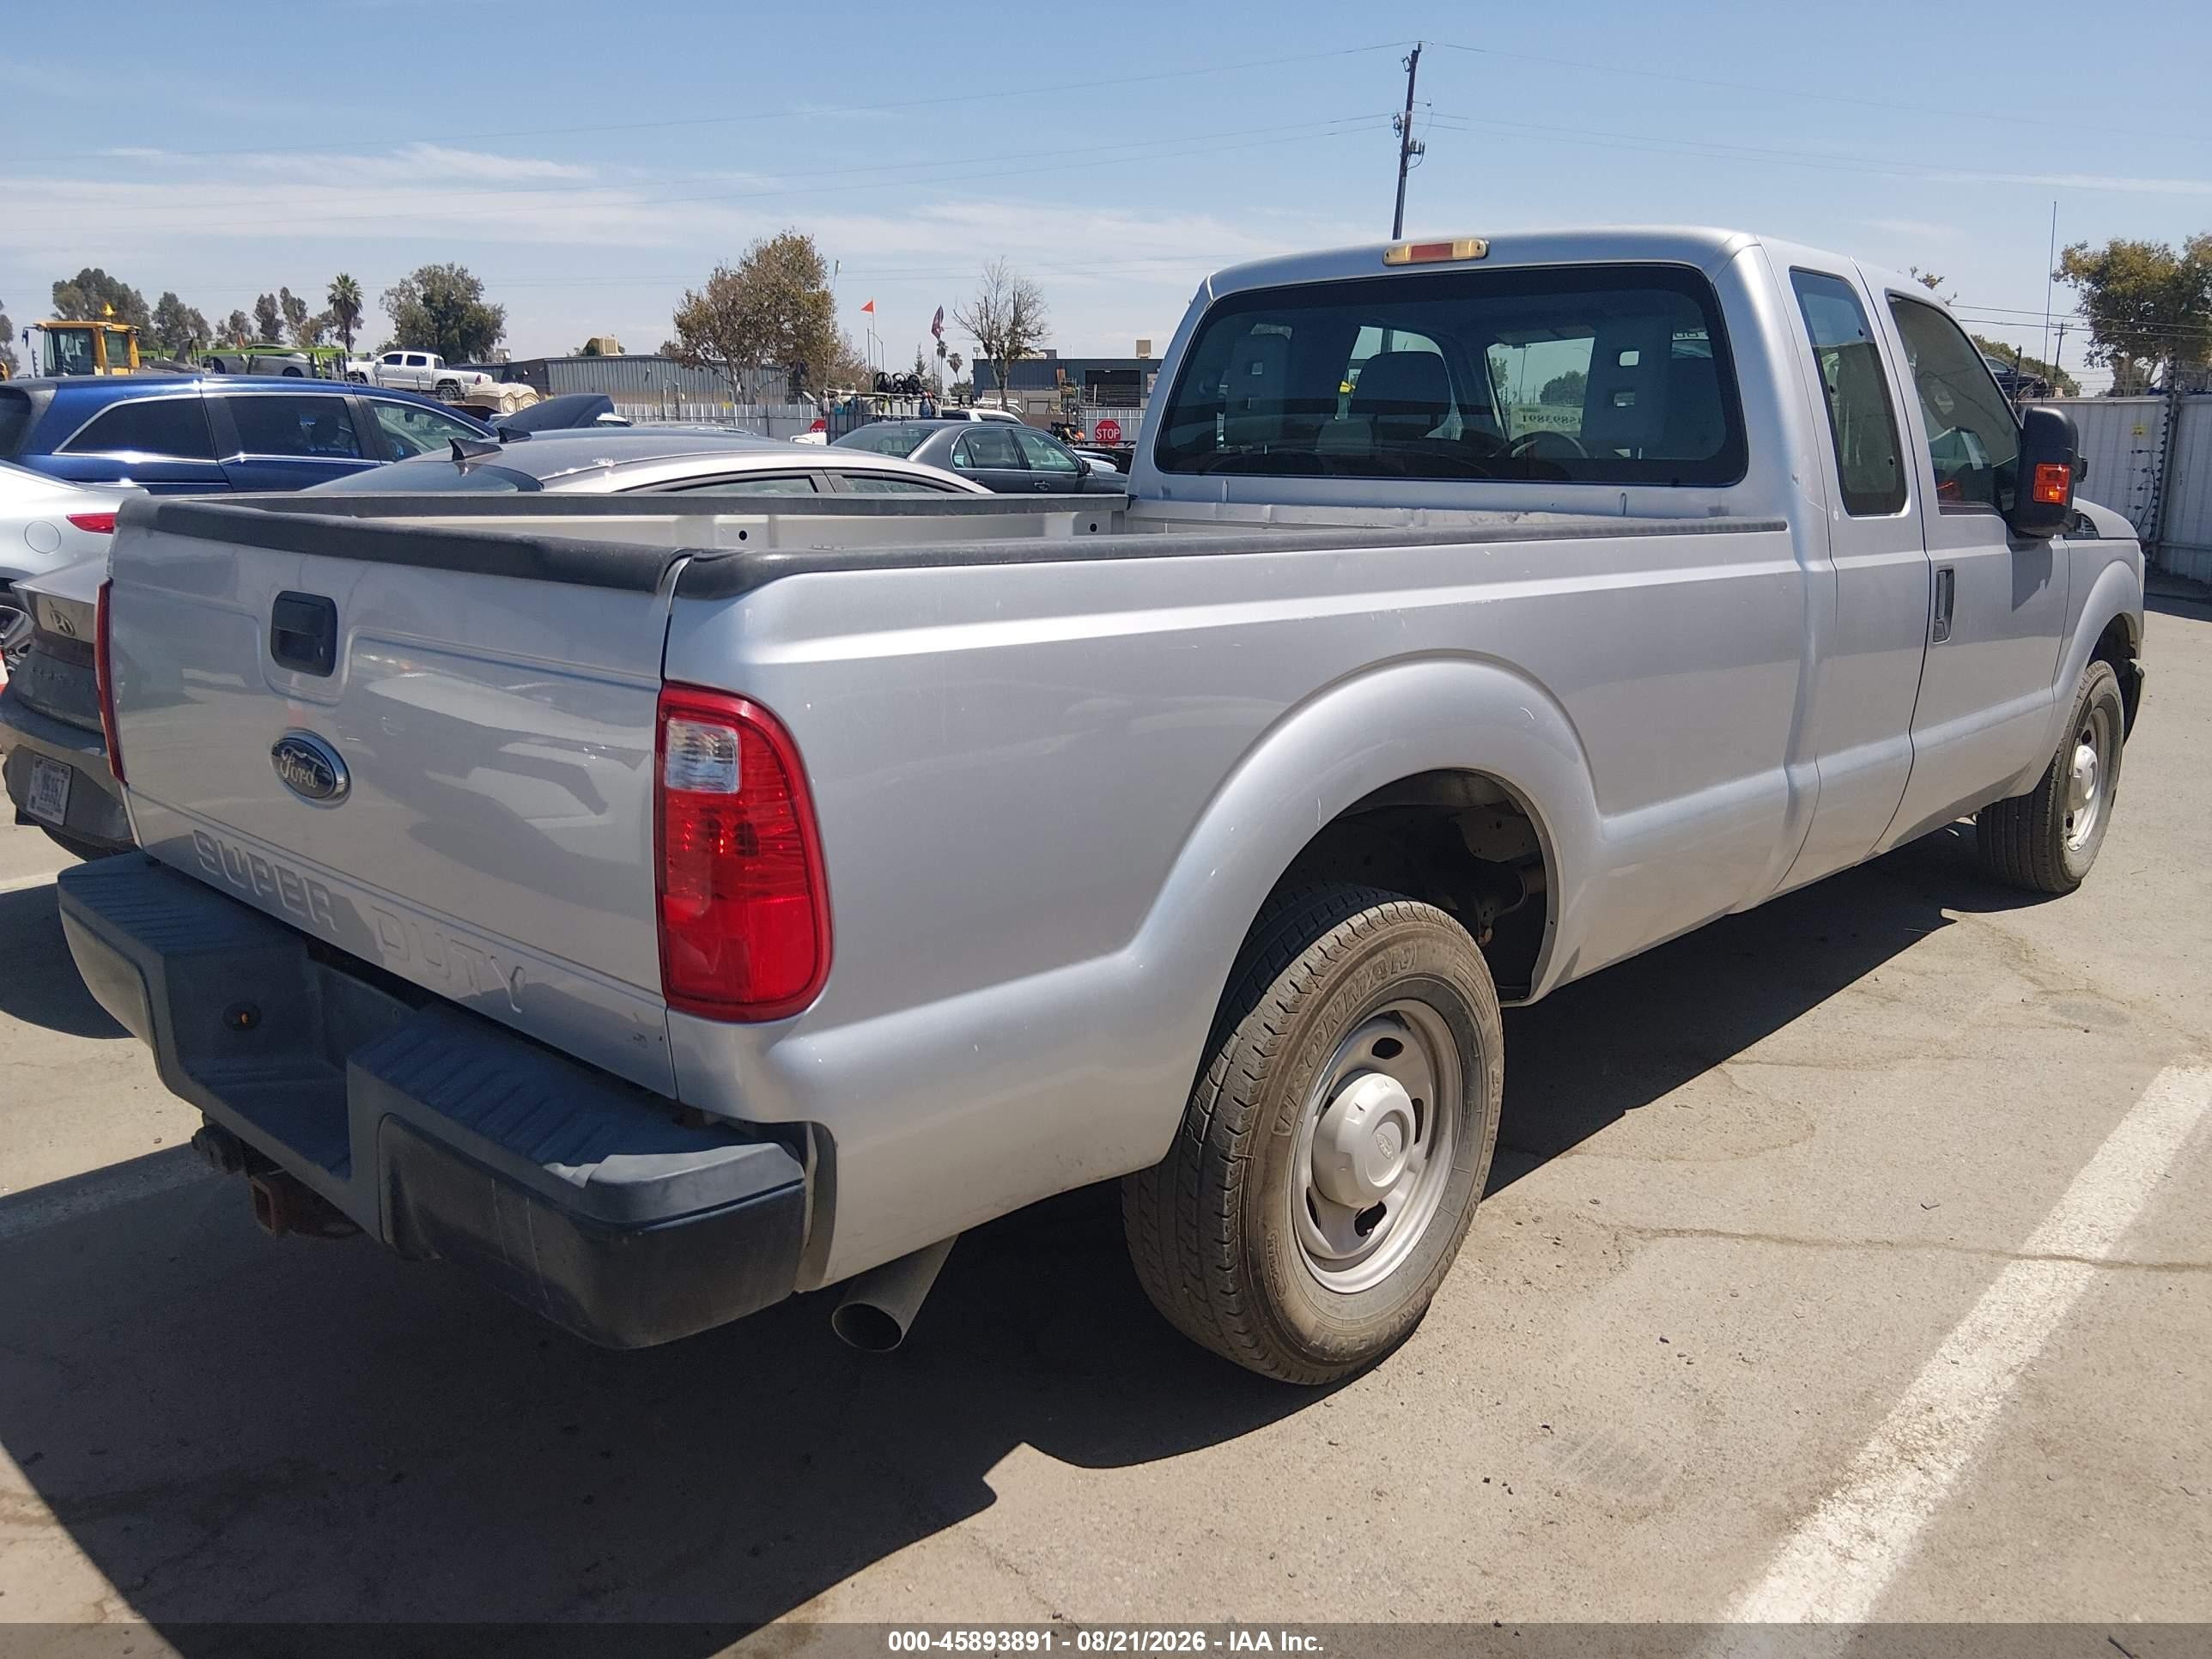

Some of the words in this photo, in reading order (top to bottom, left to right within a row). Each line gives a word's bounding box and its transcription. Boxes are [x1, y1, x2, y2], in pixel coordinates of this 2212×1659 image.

[1096, 428, 1121, 440] STOP
[279, 744, 319, 788] Ford
[191, 829, 340, 933] SUPER
[370, 904, 526, 1014] DUTY
